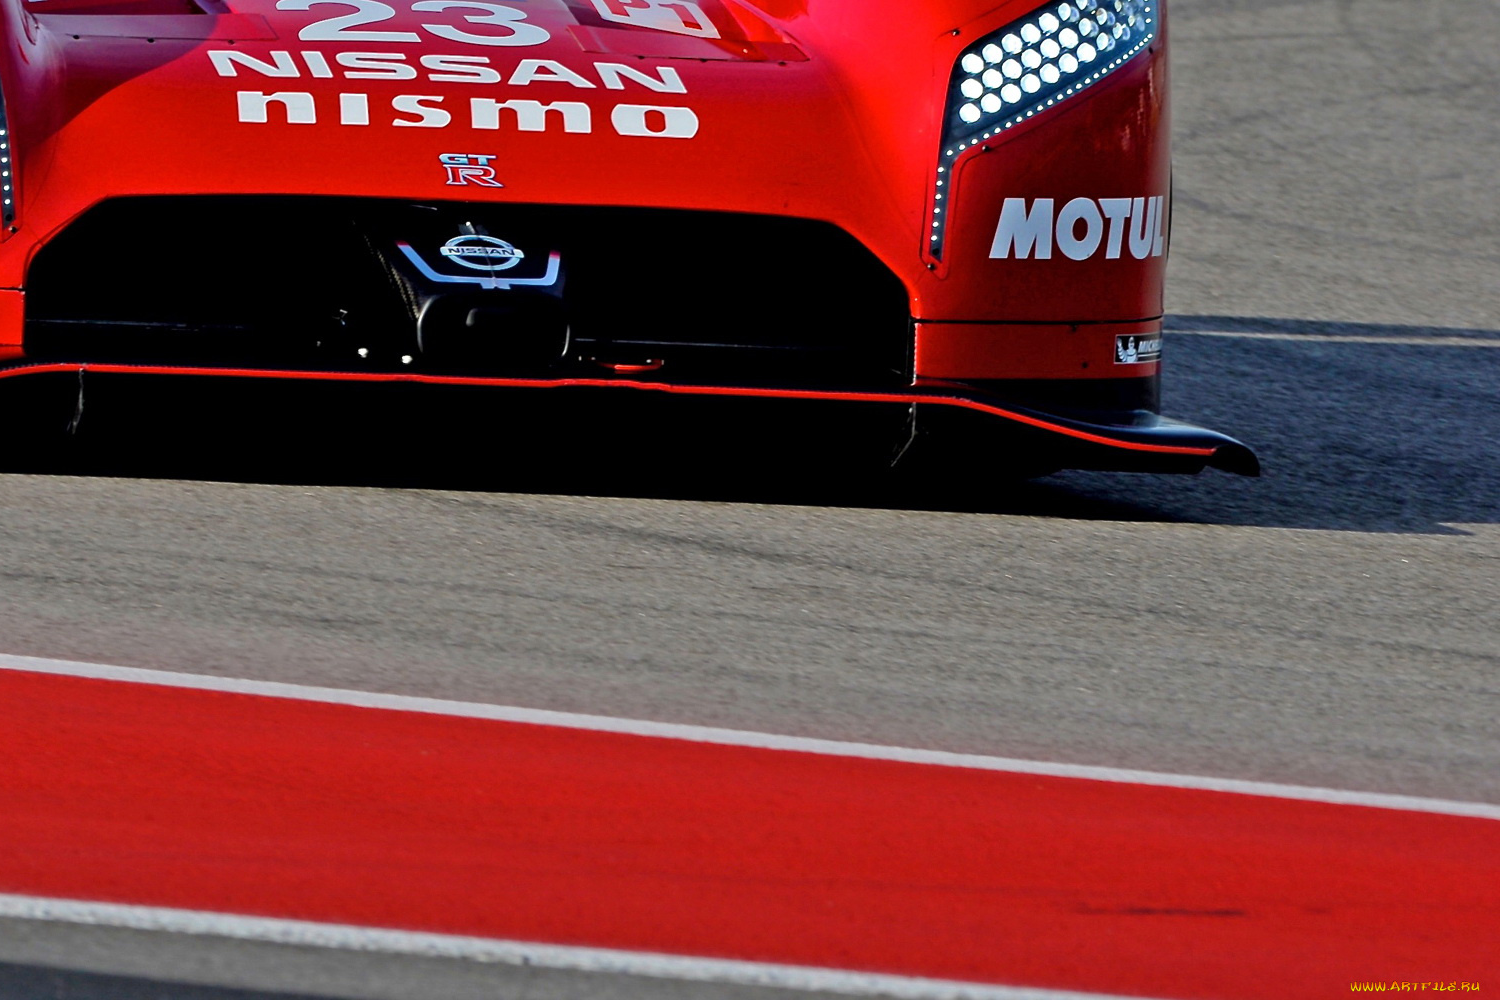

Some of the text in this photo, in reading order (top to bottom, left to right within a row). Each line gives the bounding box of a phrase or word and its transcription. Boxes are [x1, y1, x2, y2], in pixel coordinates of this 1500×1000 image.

[207, 50, 688, 94] NISSAN
[439, 153, 497, 165] GT
[443, 164, 504, 188] R
[988, 195, 1164, 261] MOTUL
[448, 247, 516, 257] NISSAN
